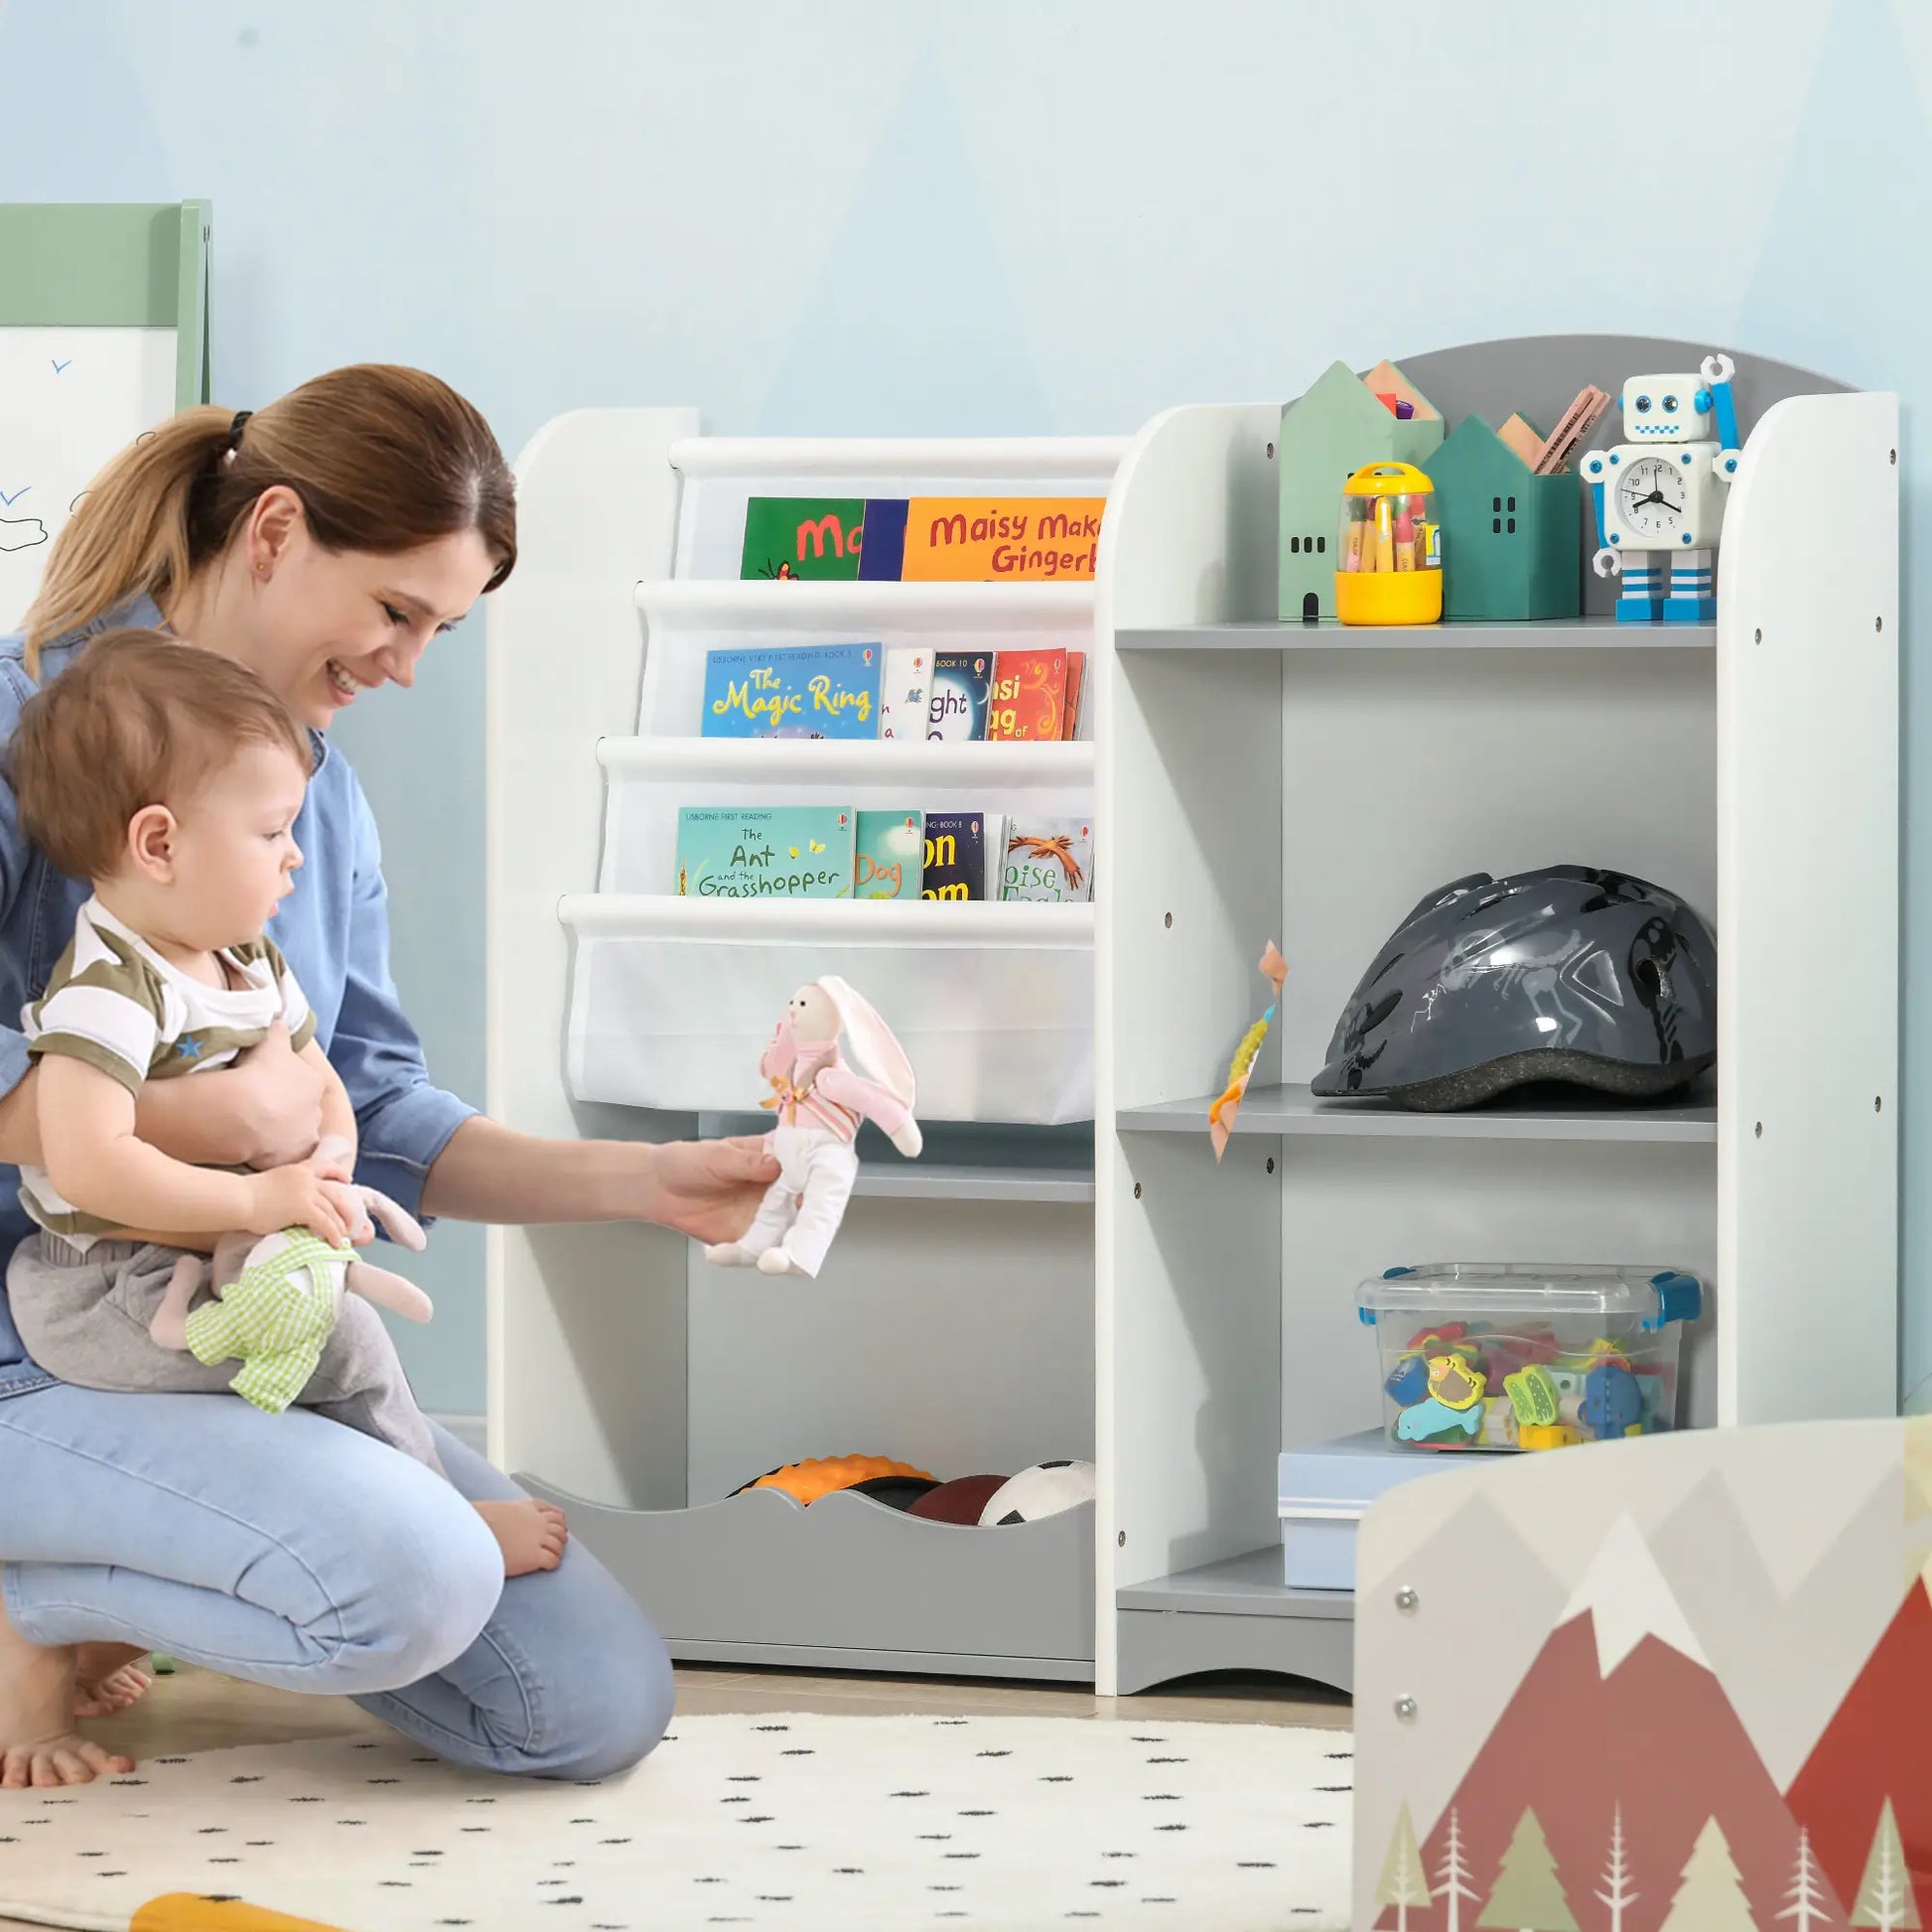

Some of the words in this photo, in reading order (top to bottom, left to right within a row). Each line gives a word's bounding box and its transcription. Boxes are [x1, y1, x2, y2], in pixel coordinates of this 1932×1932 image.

[1631, 478, 1640, 486] 10
[929, 509, 1028, 547] Maisy
[750, 667, 781, 689] The
[712, 680, 802, 726] Magic
[808, 675, 872, 722] Ring
[929, 689, 967, 724] ght
[1015, 726, 1029, 738] of
[686, 812, 720, 821] USBORNE
[721, 812, 739, 821] FIRST
[741, 812, 771, 821] READING
[939, 820, 957, 829] BOOK
[742, 828, 762, 841] The
[730, 844, 775, 868] Ant
[699, 871, 840, 898] Grasshopper
[717, 872, 736, 881] and
[738, 870, 755, 881] the
[855, 853, 901, 898] Dog
[1005, 865, 1056, 889] oise
